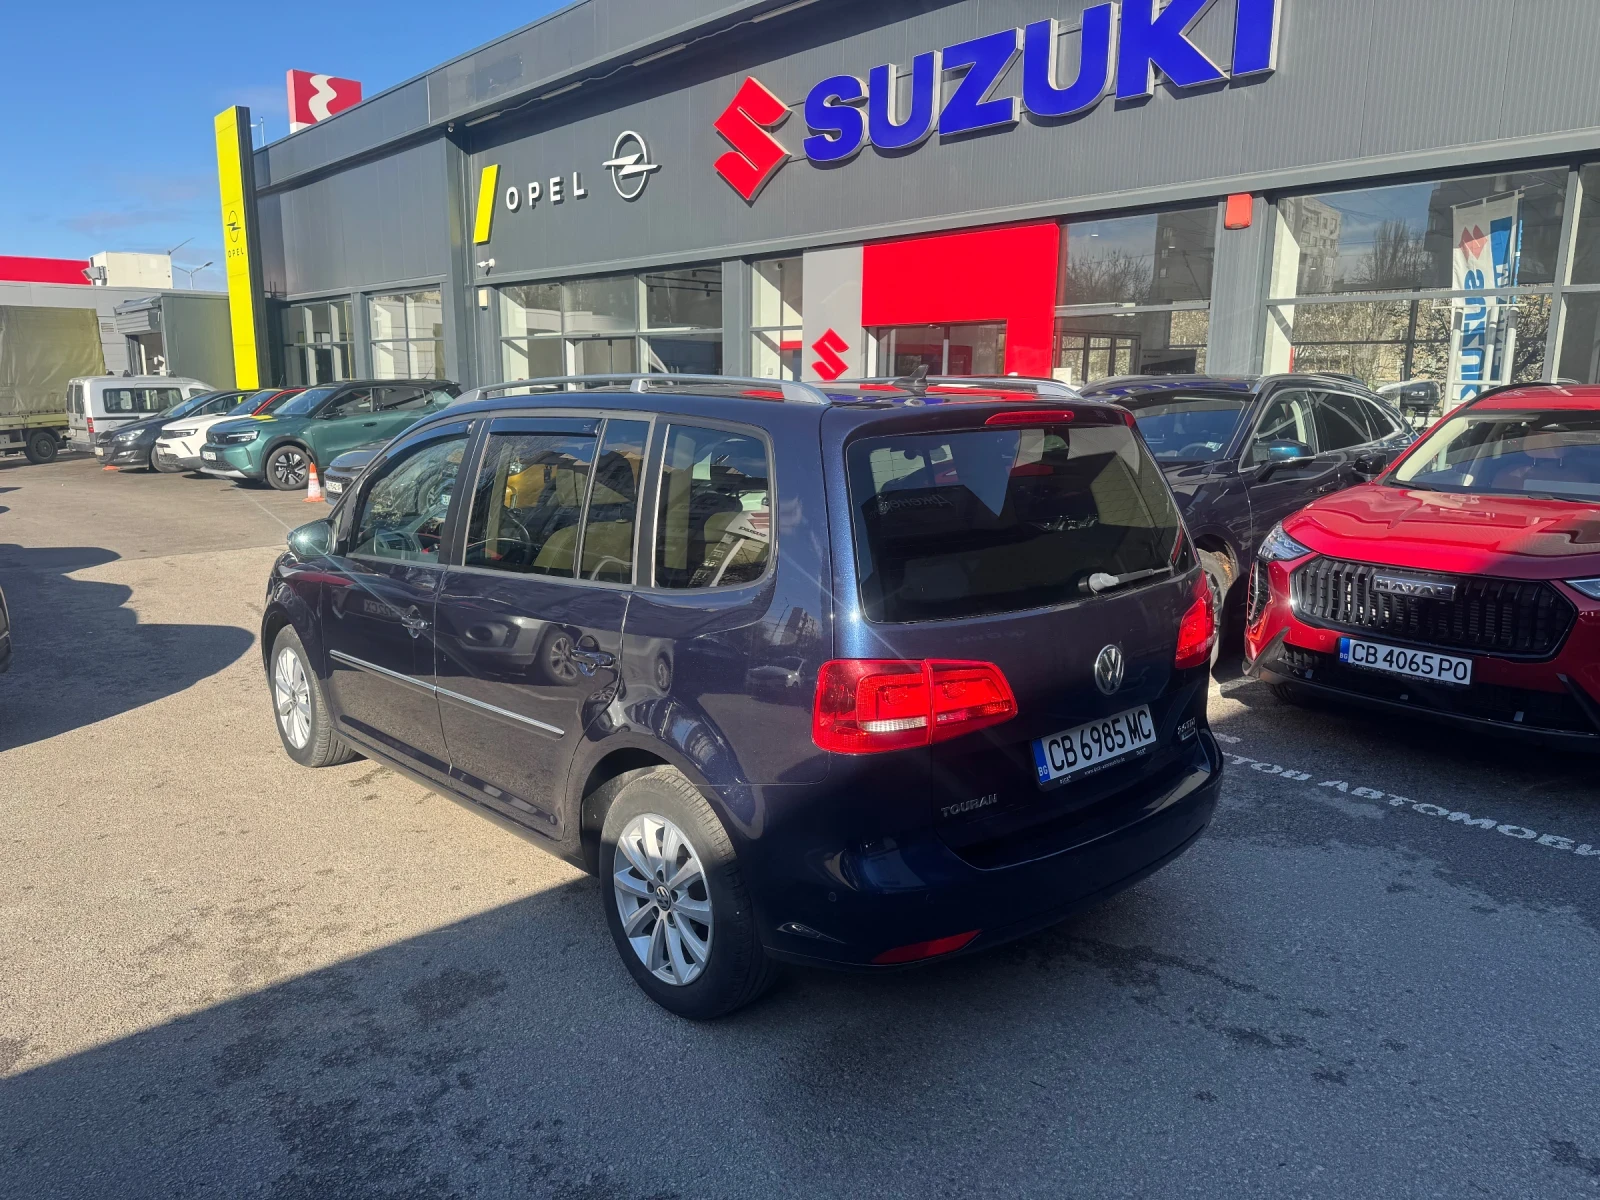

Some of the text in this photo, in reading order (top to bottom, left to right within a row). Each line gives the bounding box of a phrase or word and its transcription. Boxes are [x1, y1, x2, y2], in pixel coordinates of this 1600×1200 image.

[803, 0, 1276, 162] SUZUKI
[506, 172, 585, 210] OPEL
[228, 247, 244, 258] OPEL
[1339, 652, 1348, 660] BG
[1352, 643, 1378, 665] CB
[1382, 649, 1434, 675] 4065
[1437, 657, 1468, 681] PO
[1048, 735, 1078, 772] CB
[1080, 718, 1126, 761] 6985
[1125, 709, 1152, 745] MC
[1038, 765, 1049, 777] BG
[940, 793, 998, 818] TOURAN
